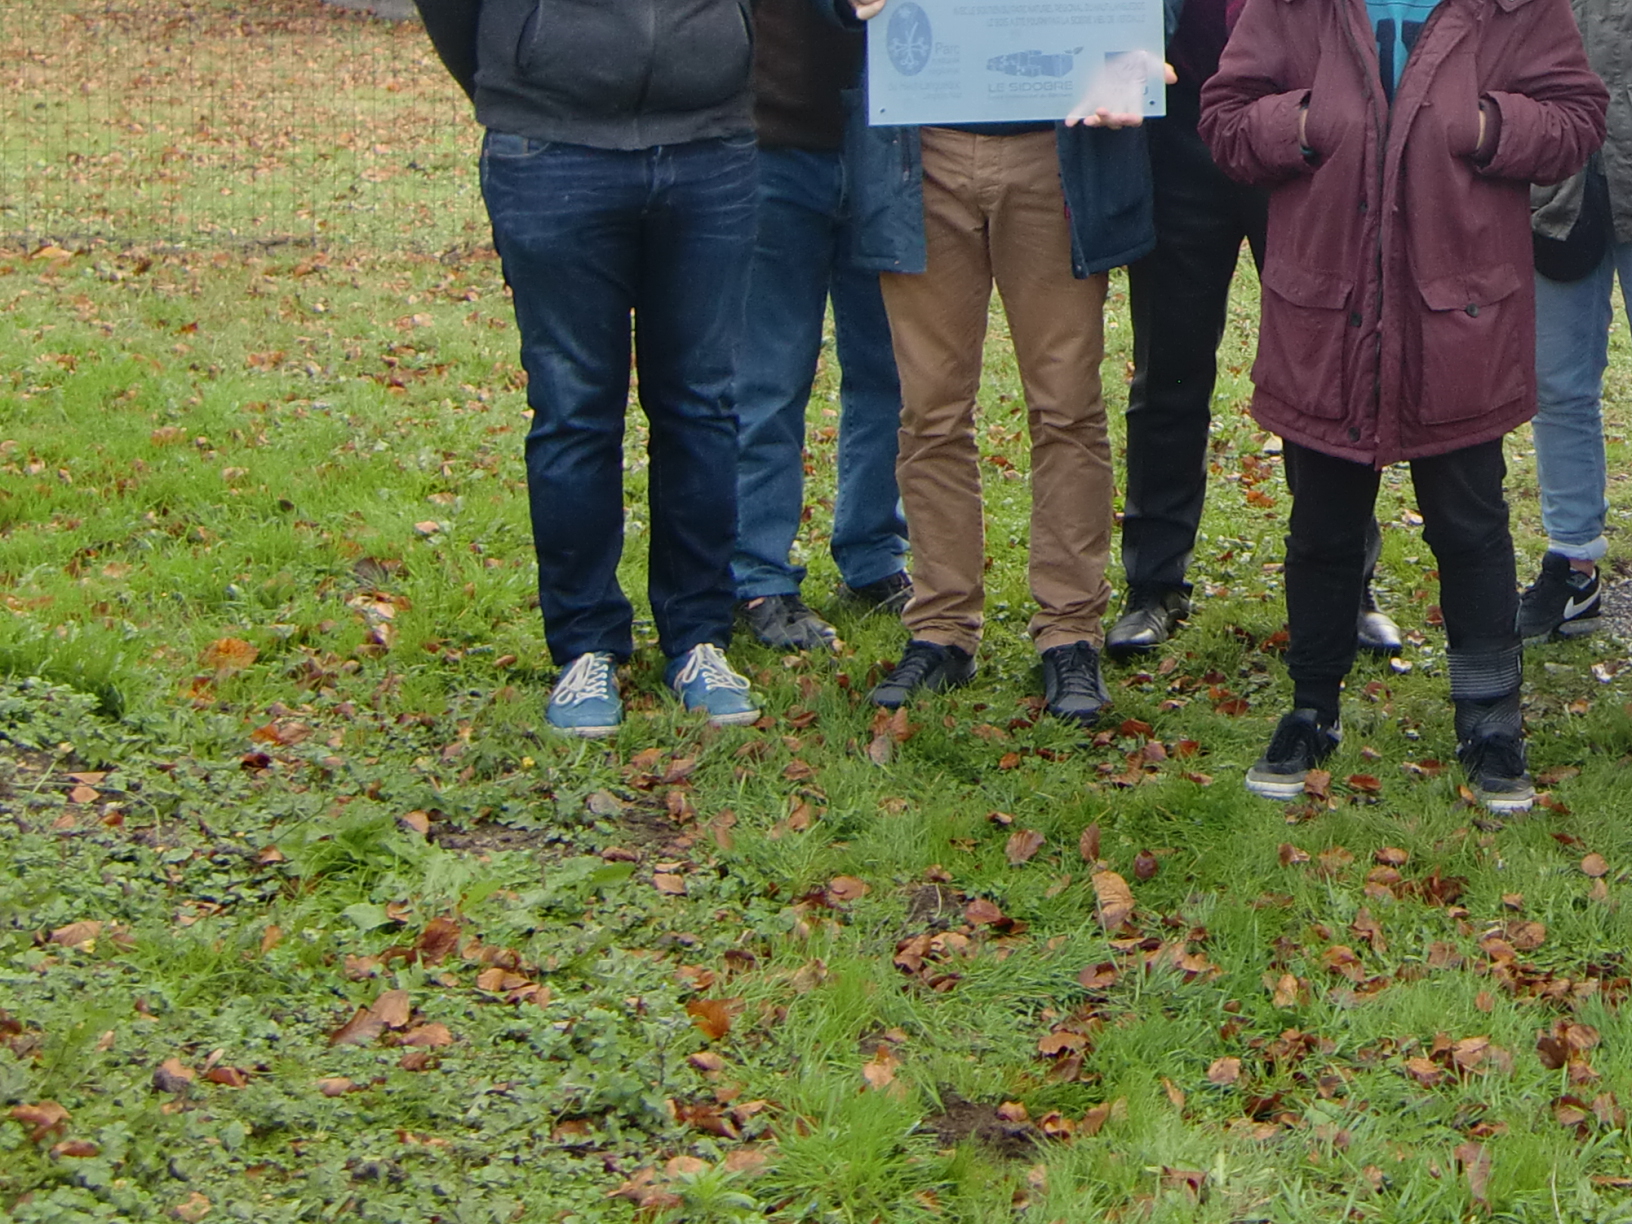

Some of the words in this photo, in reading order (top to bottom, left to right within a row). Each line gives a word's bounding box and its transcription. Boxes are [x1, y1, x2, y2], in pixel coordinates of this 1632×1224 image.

[935, 42, 960, 55] Parc
[988, 82, 1005, 93] LE
[1008, 81, 1073, 93] SIDOBRE
